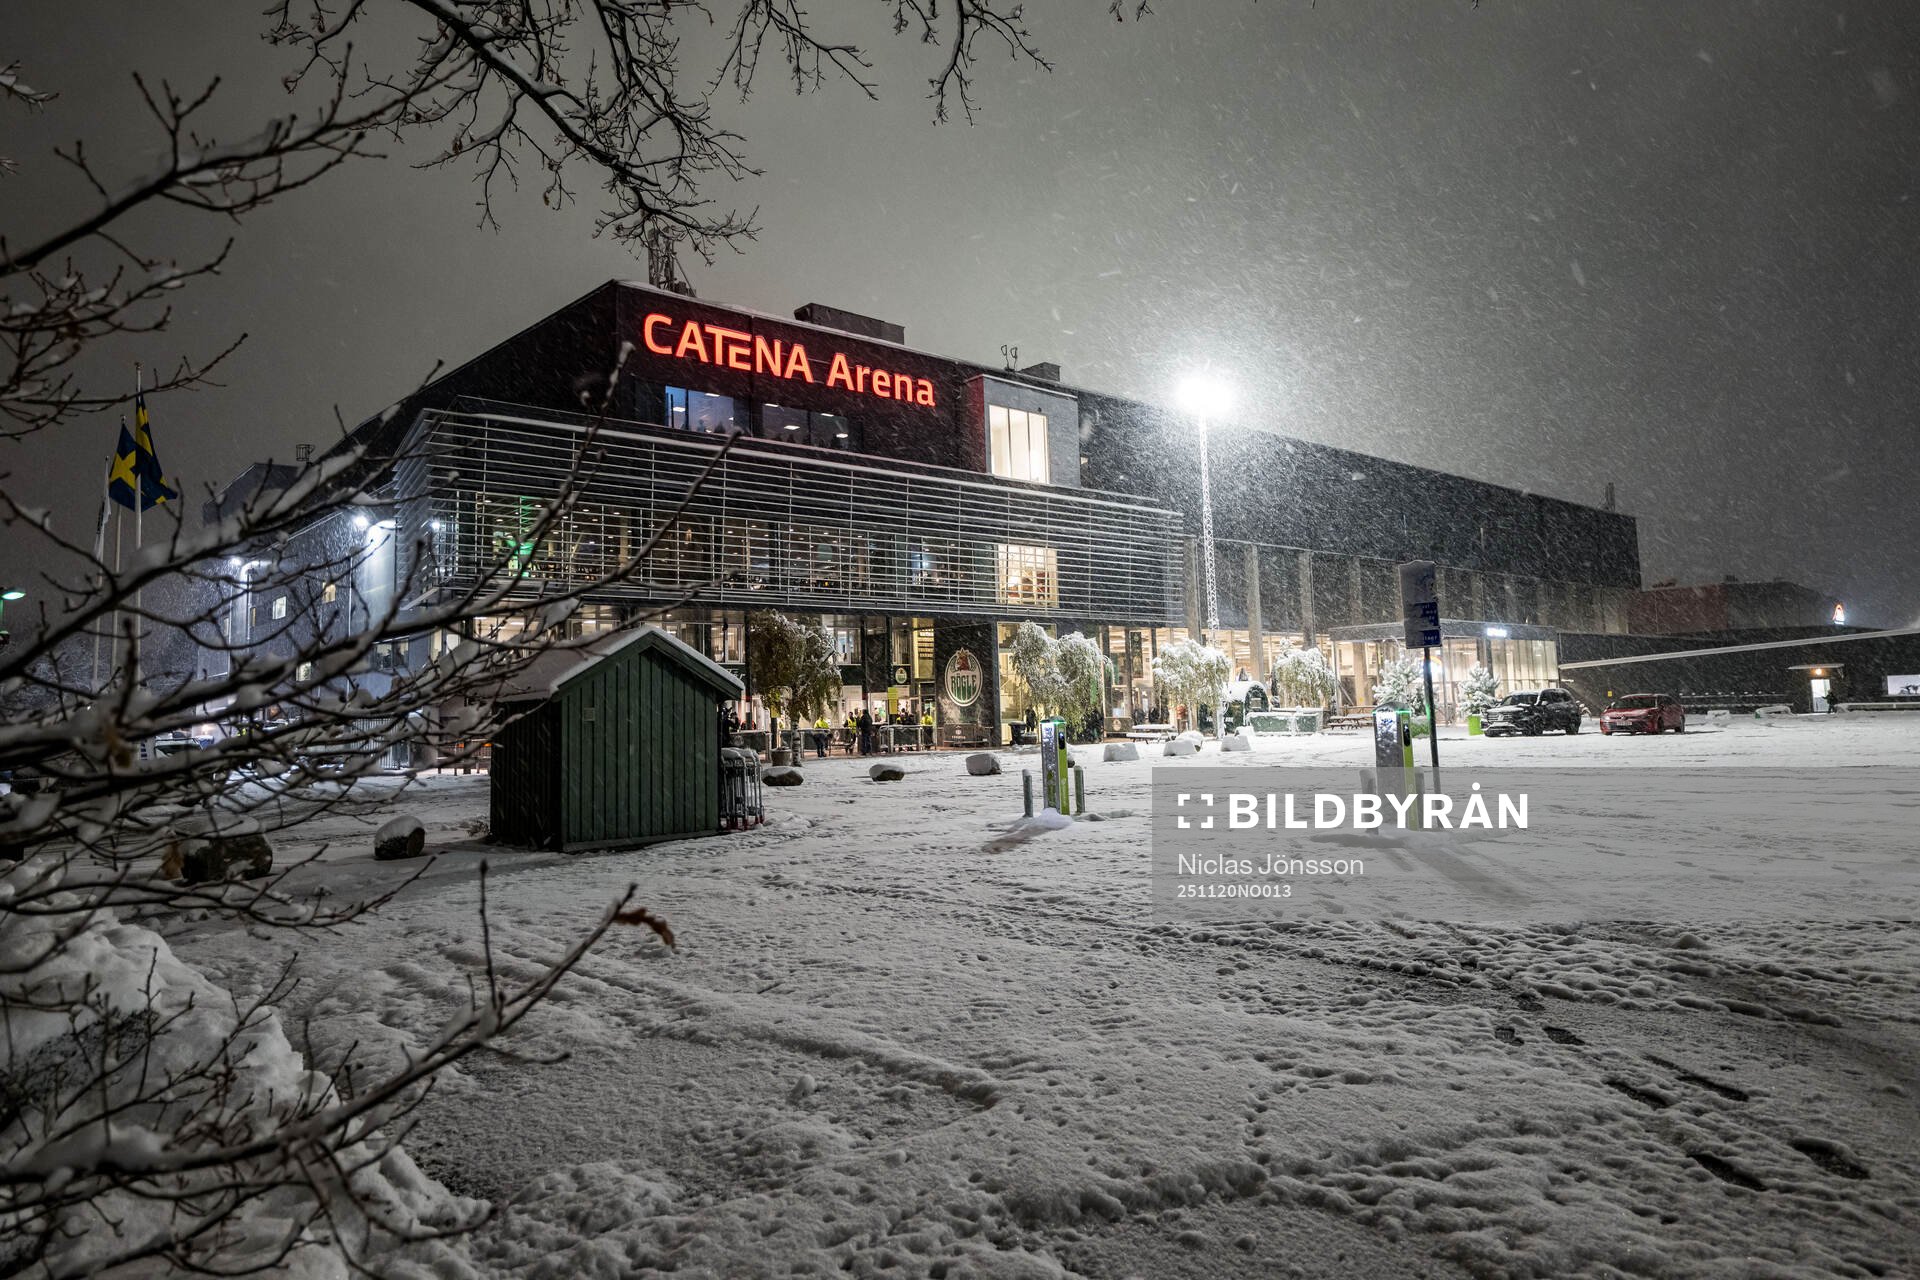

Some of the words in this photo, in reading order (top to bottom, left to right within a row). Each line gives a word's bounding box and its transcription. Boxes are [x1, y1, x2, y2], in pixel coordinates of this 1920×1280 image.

[643, 313, 814, 384] CATENA
[826, 352, 936, 407] Arena
[950, 672, 977, 690] RÖGLE
